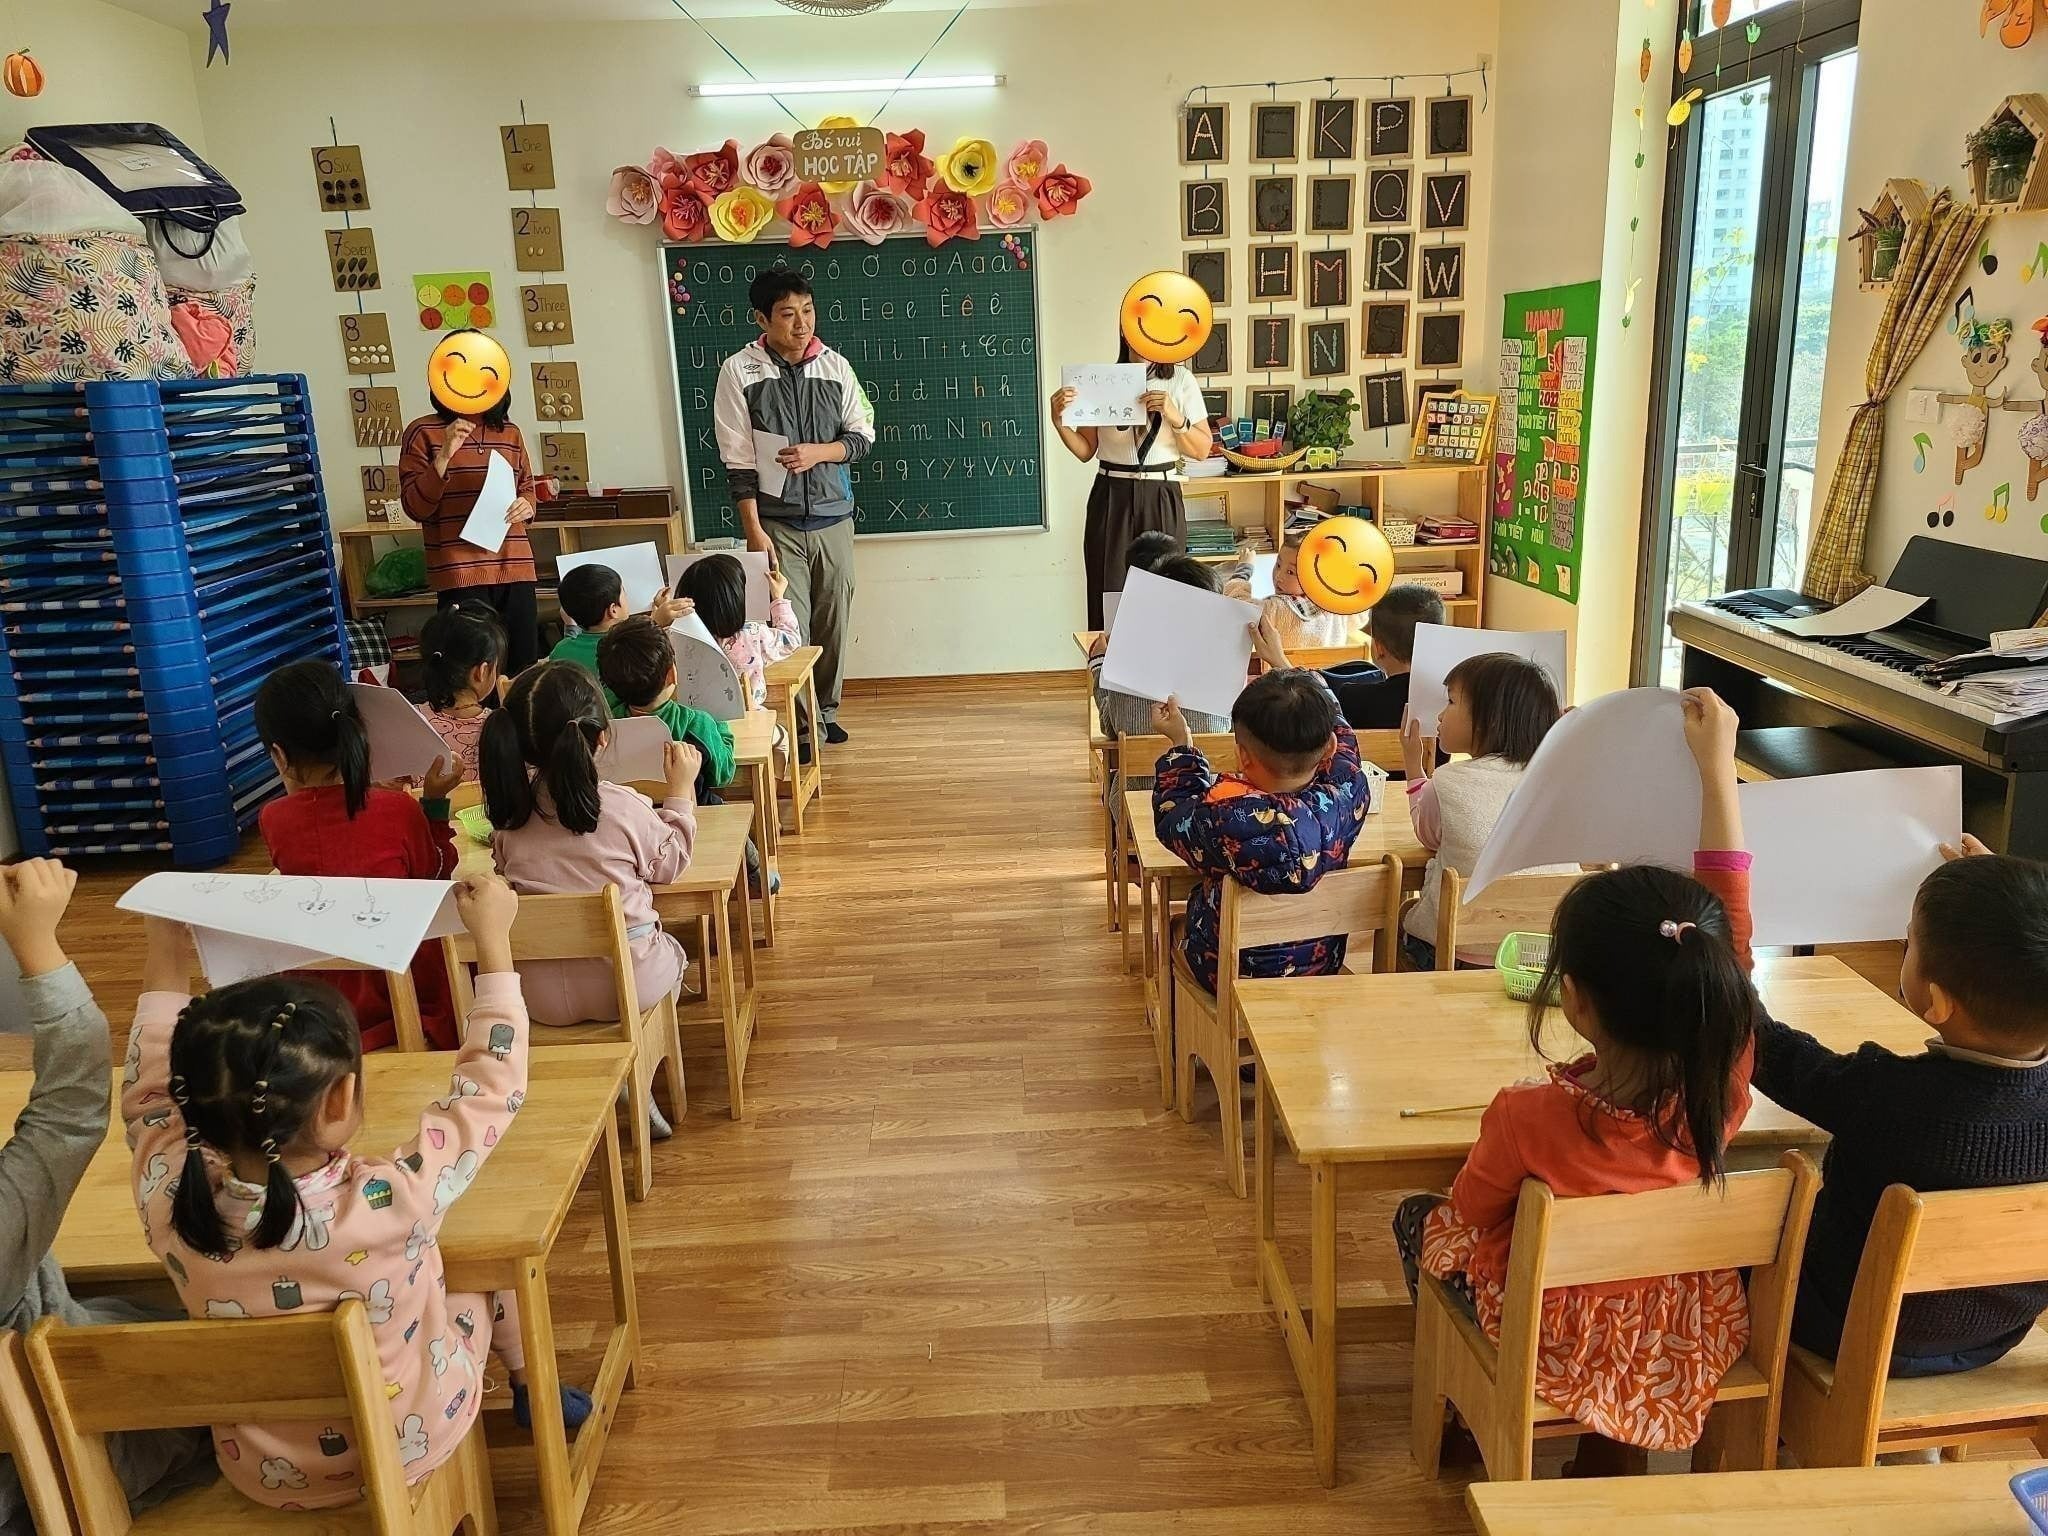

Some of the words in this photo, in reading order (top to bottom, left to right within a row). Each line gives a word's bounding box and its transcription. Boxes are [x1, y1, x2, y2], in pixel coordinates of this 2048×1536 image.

[506, 128, 523, 154] 1
[802, 130, 834, 150] Bé
[837, 132, 862, 147] vui
[1191, 112, 1218, 155] A
[1319, 105, 1346, 152] K
[1377, 104, 1403, 143] P
[317, 148, 333, 174] 6
[804, 155, 840, 181] HỌC
[843, 149, 878, 178] TẬP
[1192, 185, 1220, 232] B
[1374, 173, 1404, 218] Q
[1431, 181, 1461, 222] V
[516, 210, 530, 235] 2
[529, 220, 551, 235] Two
[329, 231, 343, 256] 7
[1374, 236, 1404, 289] R
[1260, 252, 1288, 293] H
[1314, 258, 1342, 303] M
[1425, 254, 1459, 295] W
[525, 289, 539, 312] 3
[537, 297, 566, 312] Three
[344, 316, 360, 341] 8
[1266, 321, 1281, 364] I
[1314, 329, 1337, 368] N
[536, 365, 549, 389] 4
[353, 389, 367, 413] 9
[1368, 375, 1401, 422] T
[545, 434, 558, 457] 5
[363, 468, 385, 492] 10
